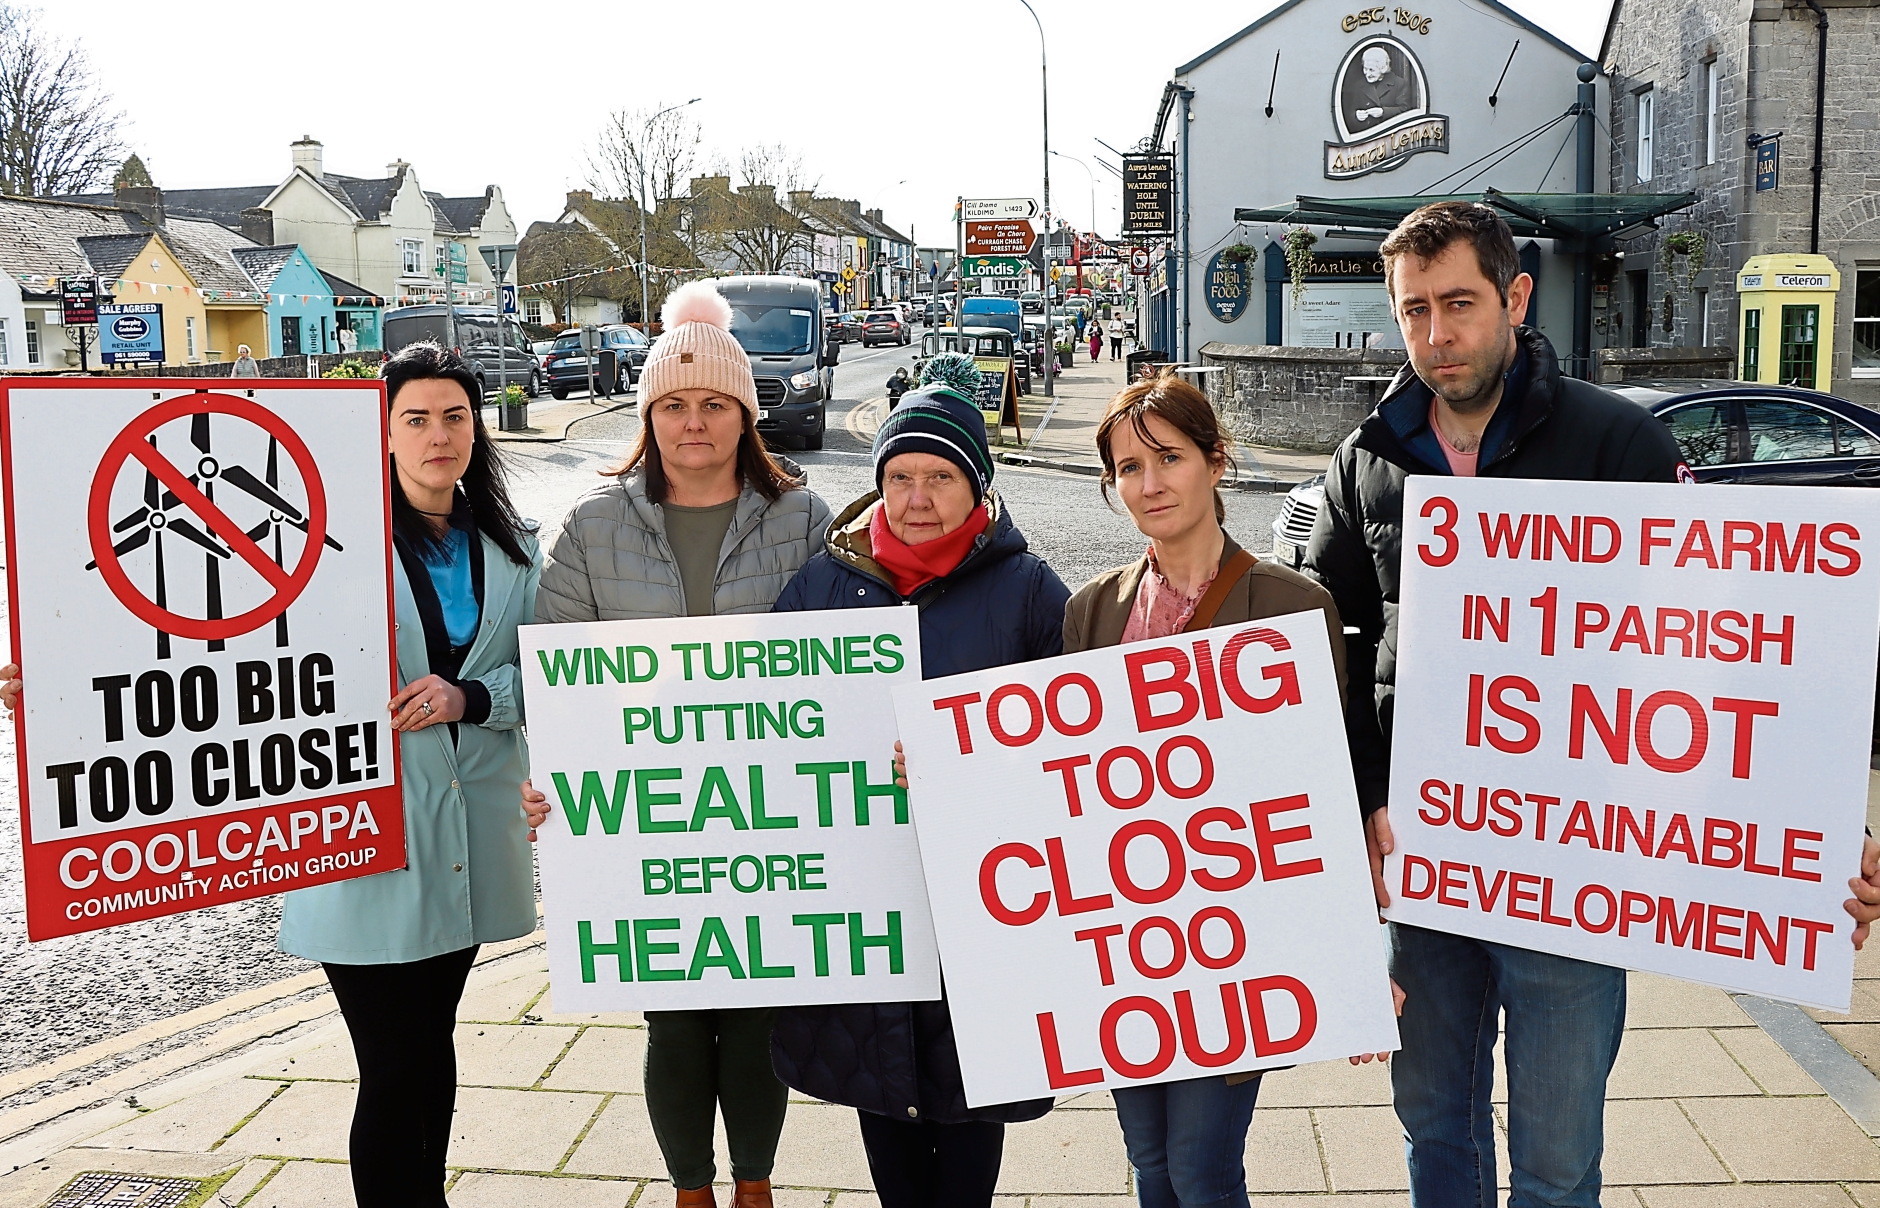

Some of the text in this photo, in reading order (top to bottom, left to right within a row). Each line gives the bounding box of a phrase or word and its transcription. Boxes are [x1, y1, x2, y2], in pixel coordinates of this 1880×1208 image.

[1394, 7, 1432, 34] 1806
[1332, 141, 1386, 170] Aunty
[1758, 159, 1774, 175] BAR
[503, 290, 509, 310] P
[970, 263, 1014, 276] Londis
[1308, 260, 1361, 273] harlie
[99, 304, 156, 314] SALE AGREED
[1418, 496, 1862, 576] 3 WIND FARMS
[537, 634, 904, 686] WIND TURBINES
[1462, 586, 1795, 666] IN 1 PARISH
[92, 652, 336, 743] TOO BIG
[623, 699, 825, 744] PUTTING
[933, 627, 1302, 755] TOO BIG
[1465, 674, 1780, 780] IS NOT
[46, 721, 379, 830] TOO CLOSE!
[551, 760, 910, 836] WEALTH
[1042, 735, 1214, 818] TOO
[59, 801, 380, 890] COOLCAPPA
[978, 793, 1324, 926] CLOSE
[1418, 779, 1824, 882] SUSTAINABLE
[66, 847, 377, 920] COMMUNITY ACTION GROUP
[642, 853, 827, 896] BEFORE
[1401, 854, 1834, 971] DEVELOPMENT
[577, 911, 904, 983] HEALTH
[1075, 906, 1246, 986] TOO
[1036, 974, 1318, 1090] LOUD
